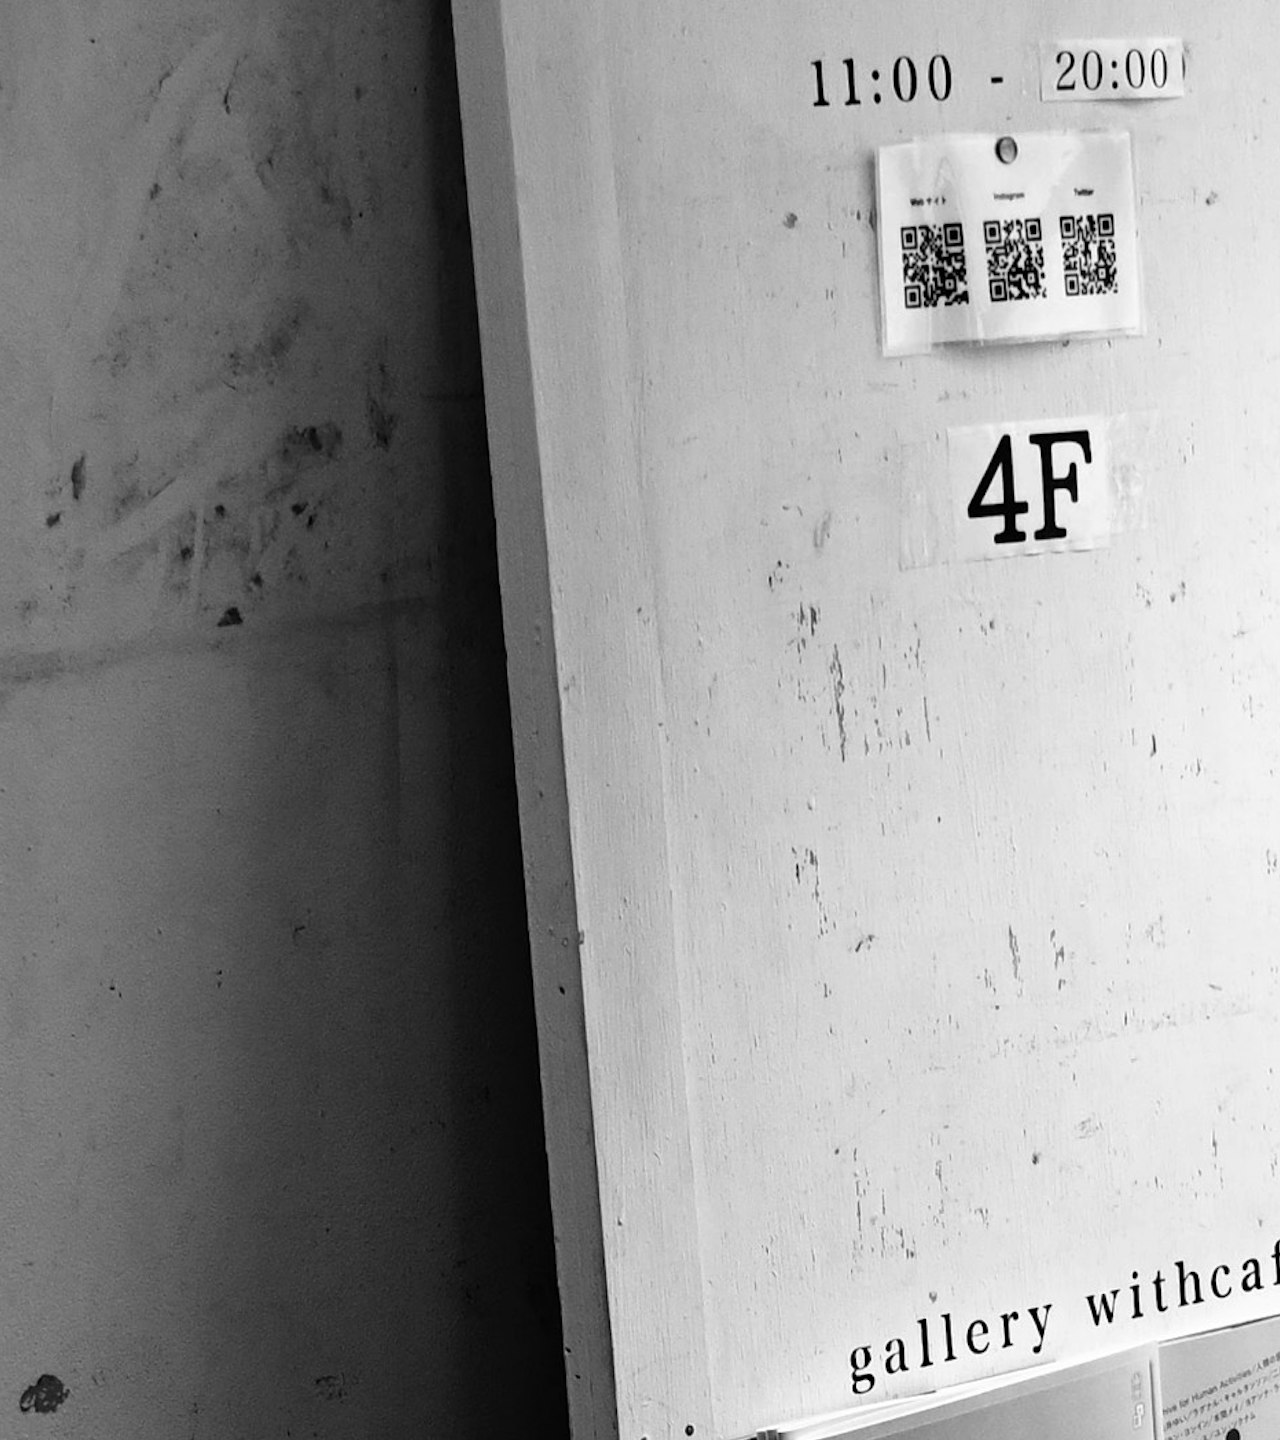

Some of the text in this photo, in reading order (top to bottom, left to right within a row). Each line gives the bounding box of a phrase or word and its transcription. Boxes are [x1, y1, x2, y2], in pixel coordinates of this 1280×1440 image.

[811, 53, 953, 108] 11:00
[1055, 48, 1169, 92] 20:00
[967, 430, 1093, 545] 4F
[849, 1301, 1054, 1394] gallery
